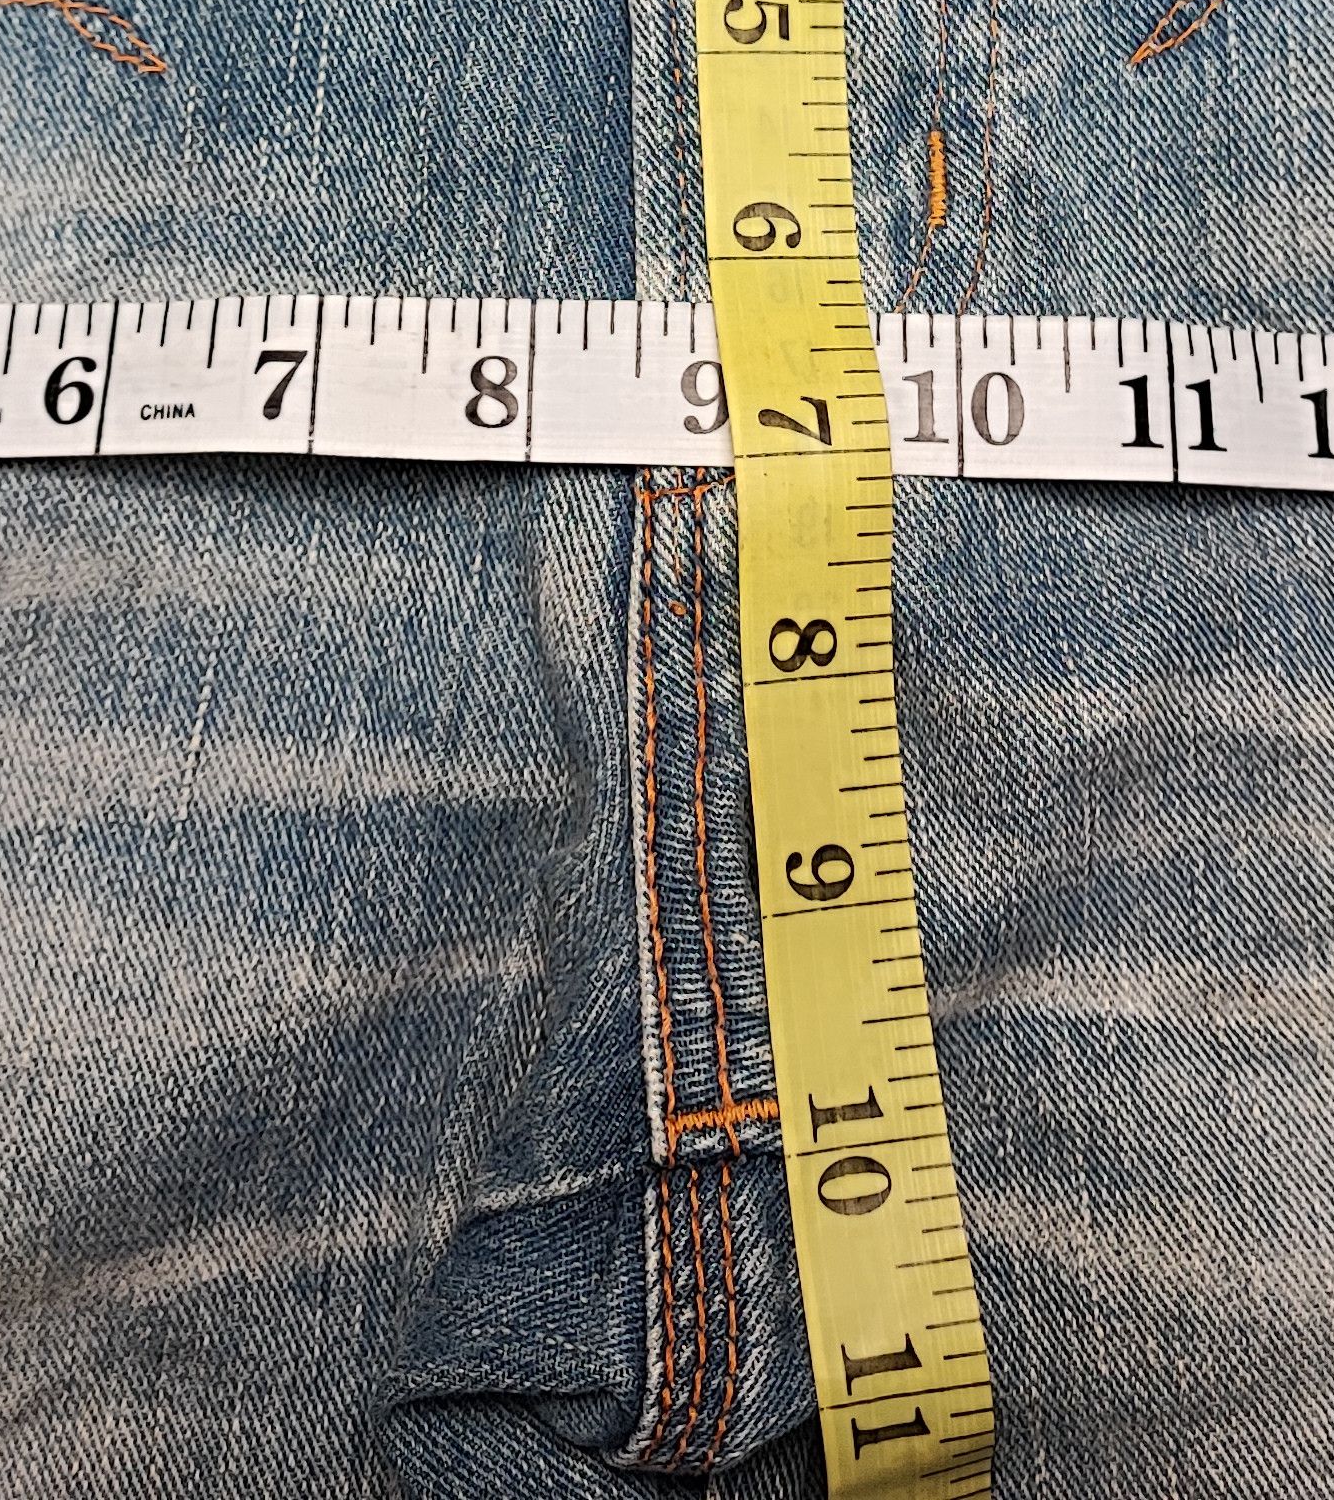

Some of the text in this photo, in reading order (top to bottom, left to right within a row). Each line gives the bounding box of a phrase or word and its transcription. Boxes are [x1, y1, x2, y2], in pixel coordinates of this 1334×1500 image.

[733, 201, 801, 252] 6
[44, 357, 98, 424] 6
[255, 350, 308, 419] 7
[465, 355, 518, 429] 8
[681, 360, 728, 434] 9
[140, 403, 195, 421] CHINA
[758, 395, 832, 445] 7
[768, 618, 838, 672] 8
[786, 844, 855, 901] 9
